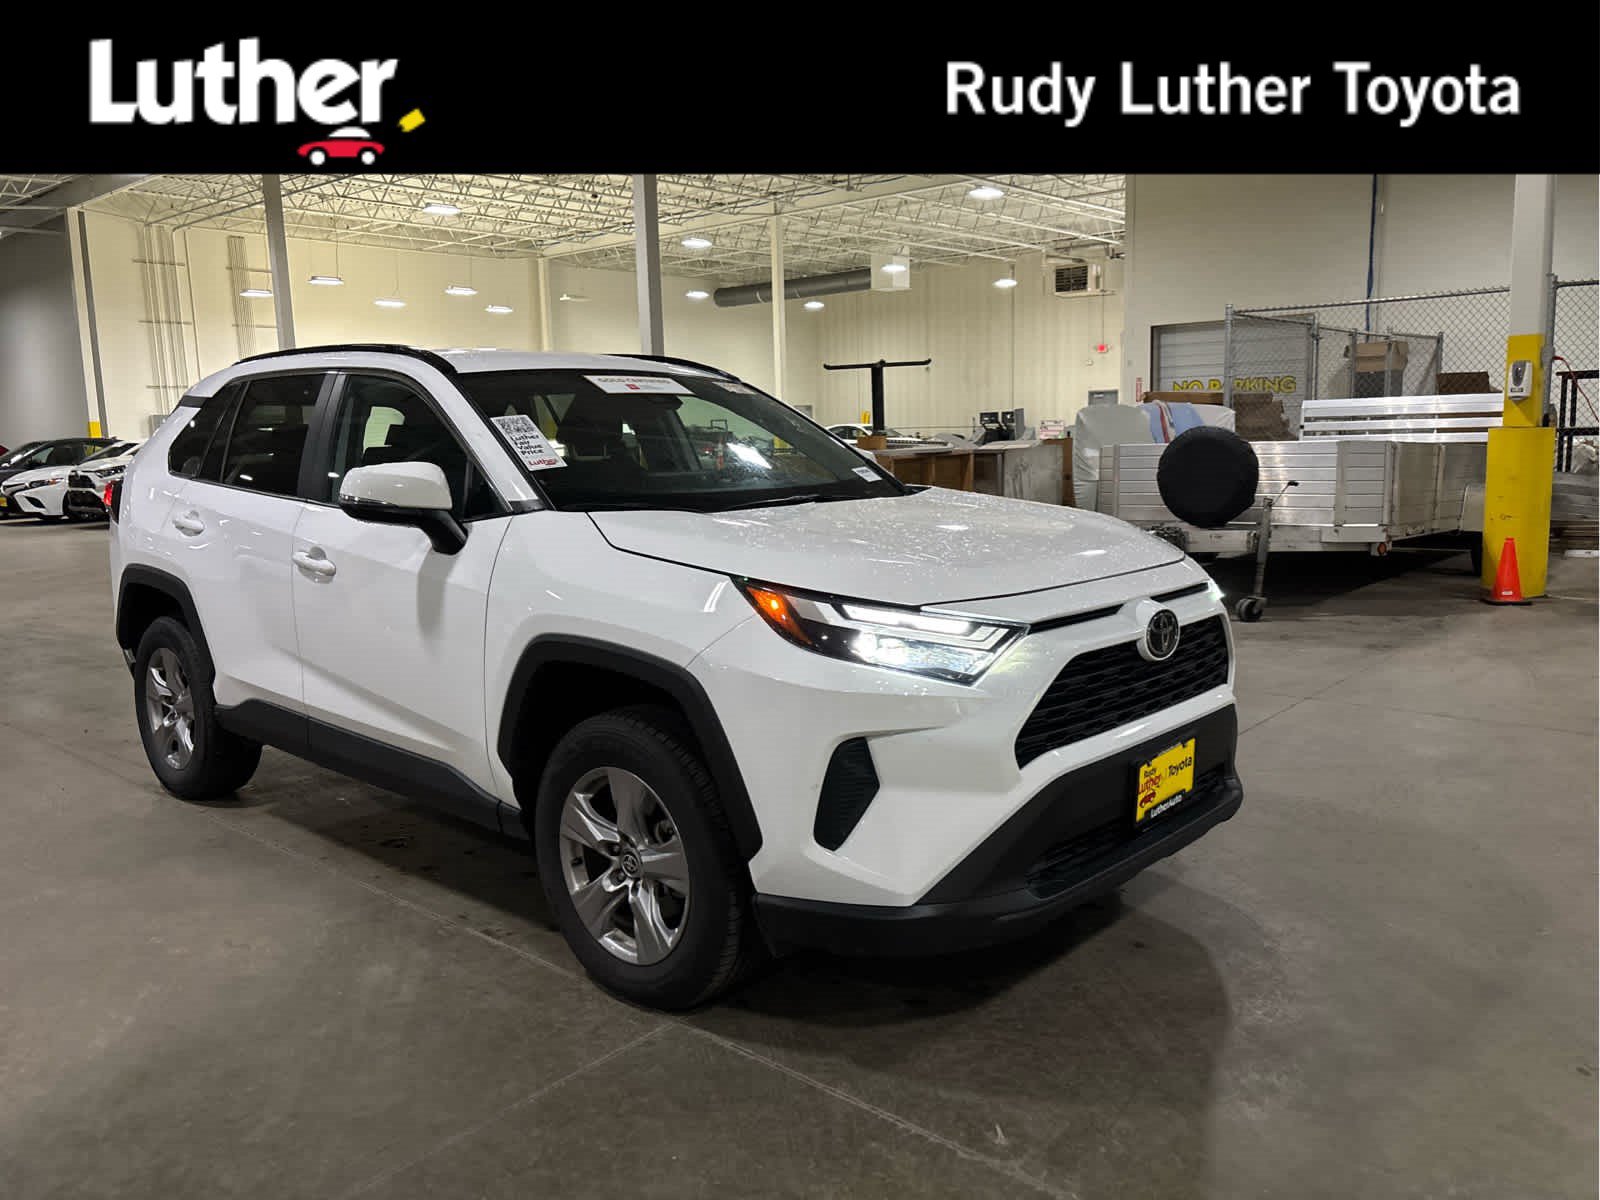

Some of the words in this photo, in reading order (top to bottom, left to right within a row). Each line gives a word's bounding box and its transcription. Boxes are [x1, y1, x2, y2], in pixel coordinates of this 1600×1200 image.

[1172, 379, 1204, 392] NO
[1208, 375, 1297, 394] PRKING
[1168, 756, 1192, 777] Toyota
